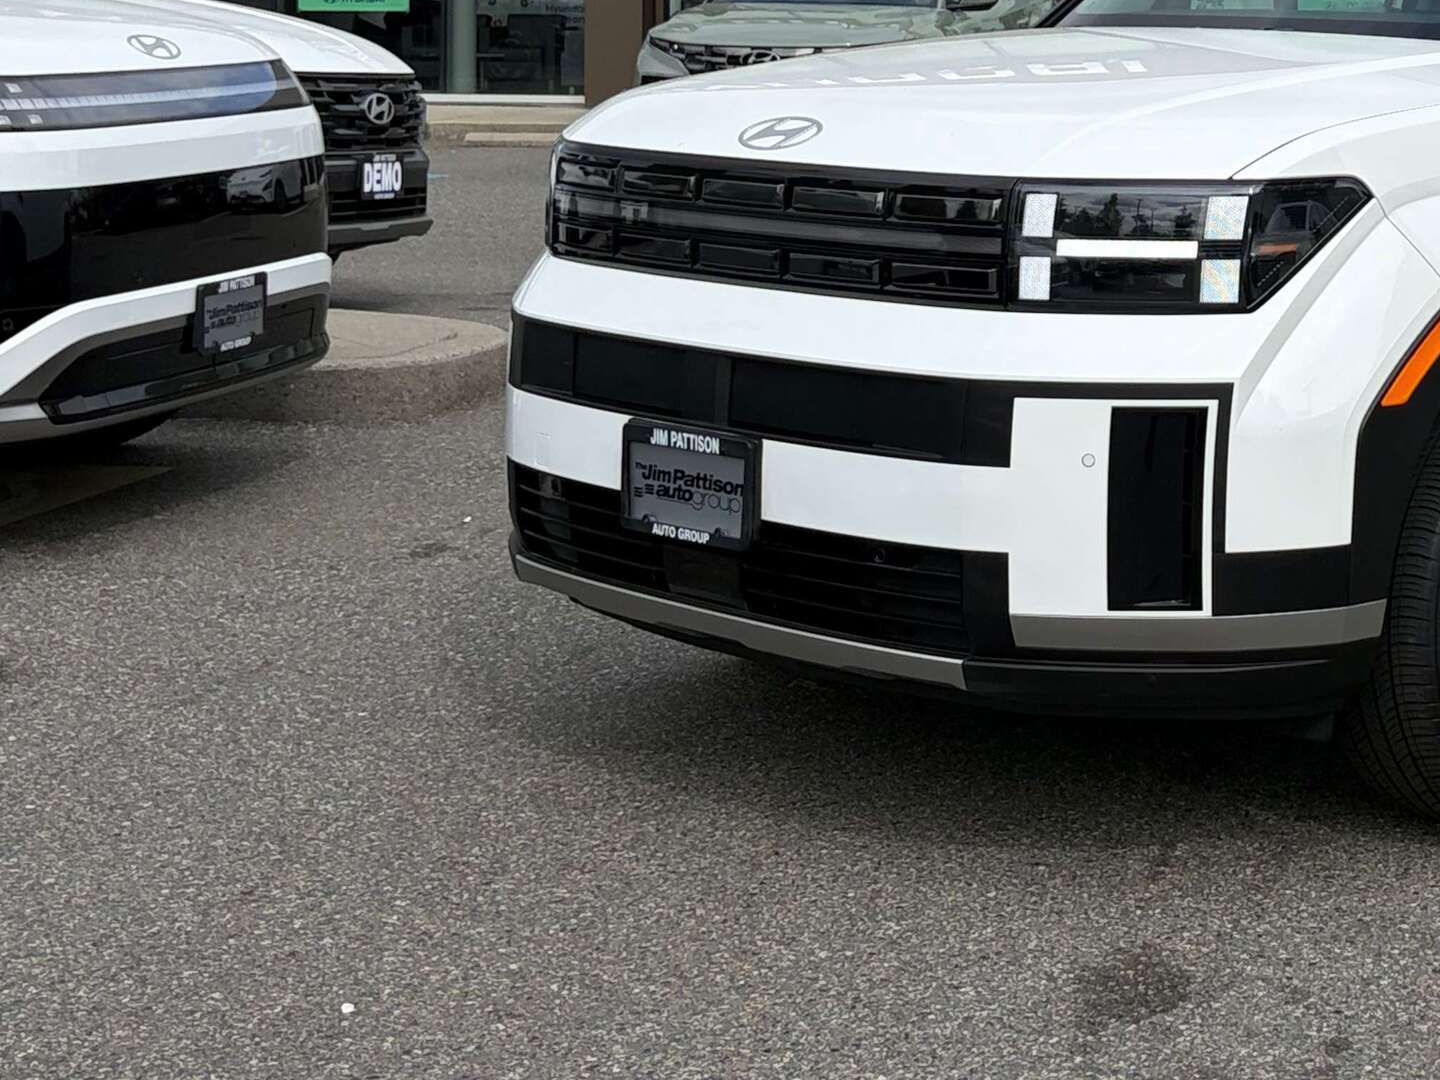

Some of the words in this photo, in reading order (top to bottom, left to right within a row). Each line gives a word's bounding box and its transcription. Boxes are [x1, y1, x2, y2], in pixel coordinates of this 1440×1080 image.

[363, 161, 402, 193] DEMO
[650, 428, 668, 446] JIM
[670, 430, 719, 454] PATTISON
[652, 523, 676, 539] AUTO
[677, 528, 710, 544] GROUP
